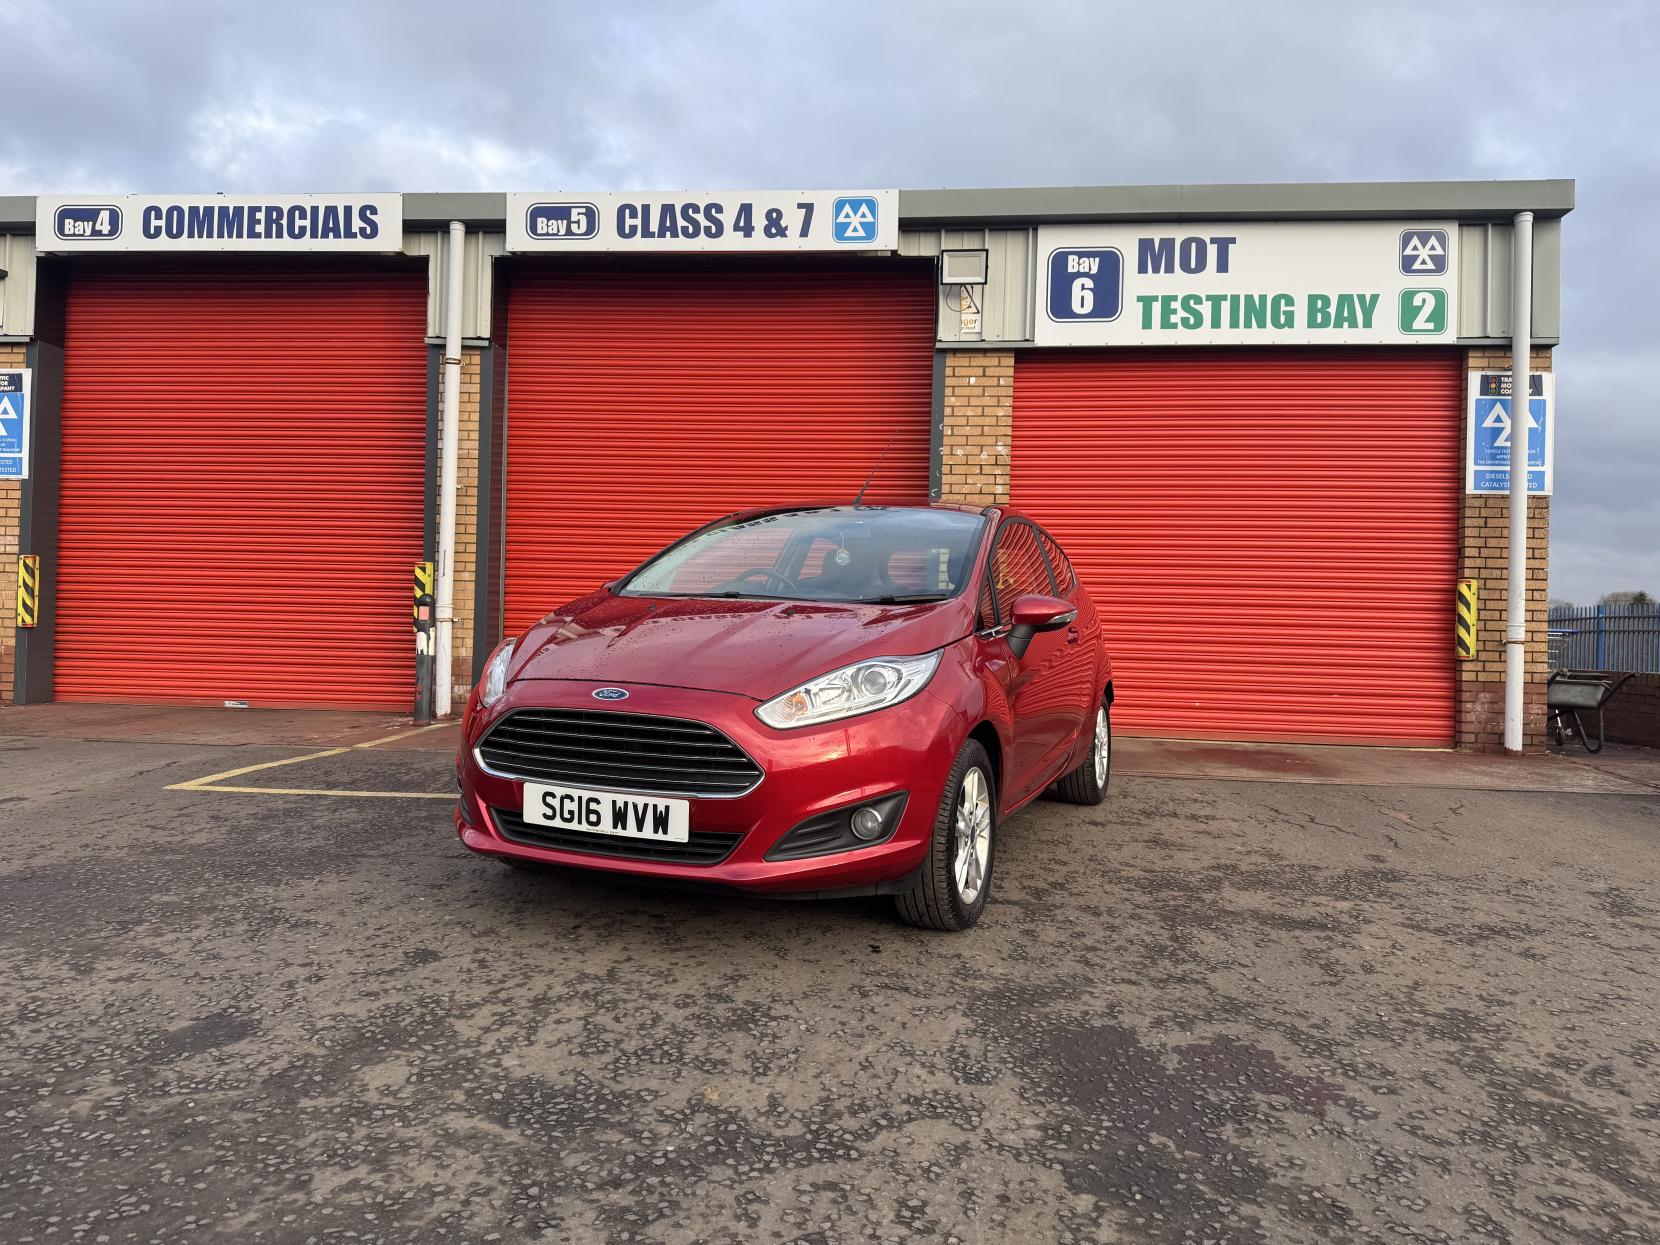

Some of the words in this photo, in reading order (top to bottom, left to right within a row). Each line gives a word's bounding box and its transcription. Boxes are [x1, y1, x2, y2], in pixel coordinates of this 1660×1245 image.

[65, 218, 93, 235] Bay
[94, 210, 111, 235] 4
[142, 205, 379, 239] COMMERCIALS
[536, 217, 568, 235] Bay
[570, 207, 587, 234] 5
[616, 203, 725, 239] CLASS
[732, 203, 755, 239] 4
[763, 207, 789, 239] &
[796, 203, 815, 238] 7
[1067, 254, 1100, 274] Bay
[1137, 237, 1237, 273] MOT
[1071, 278, 1095, 315] 6
[1136, 294, 1295, 330] TESTING
[1306, 294, 1380, 329] BAY
[1412, 291, 1436, 330] 2
[599, 689, 621, 698] Ford
[541, 790, 602, 828] SG16
[611, 799, 671, 836] WVW
